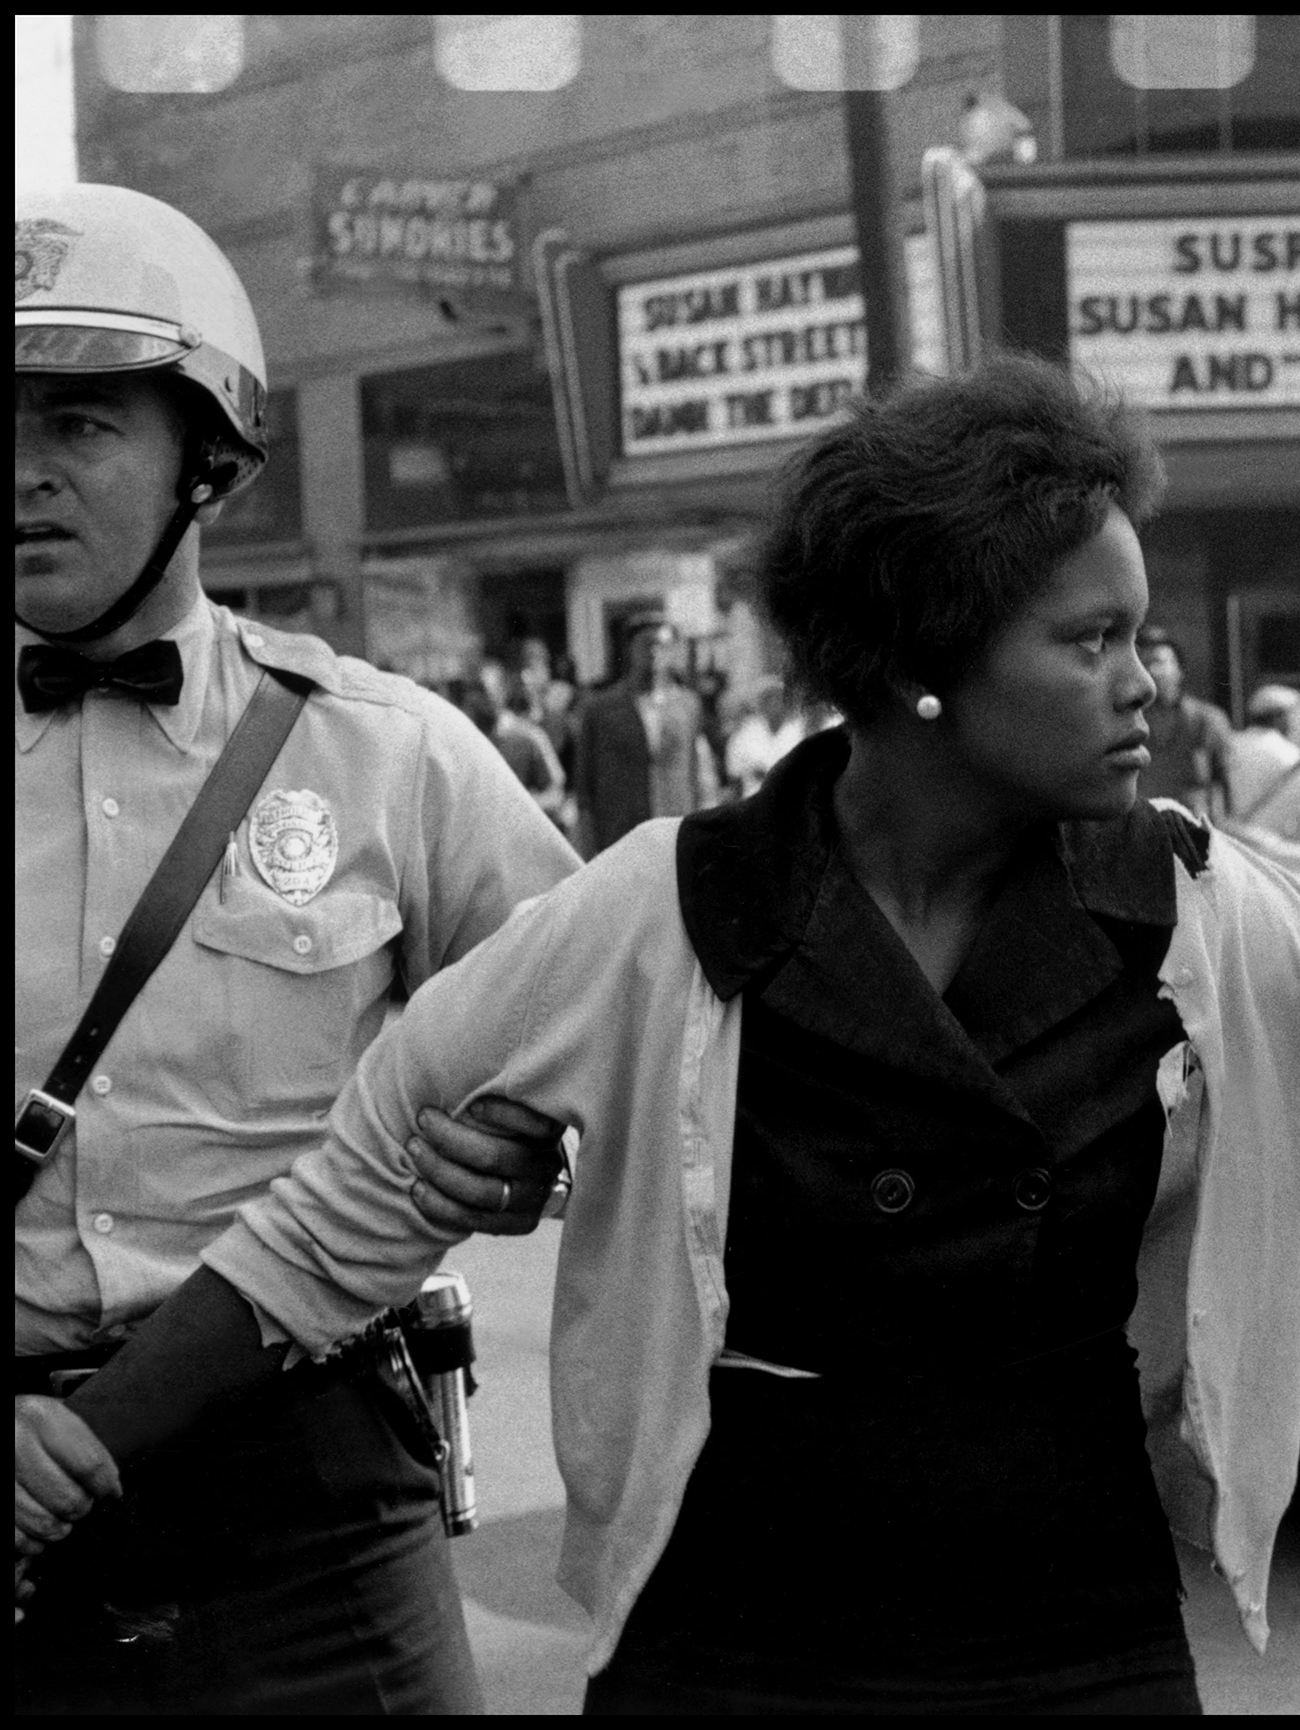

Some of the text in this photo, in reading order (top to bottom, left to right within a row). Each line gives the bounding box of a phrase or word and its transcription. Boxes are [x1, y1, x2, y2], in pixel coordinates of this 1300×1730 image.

[645, 280, 741, 334] SUSAN
[1077, 292, 1246, 337] SUSAN
[726, 390, 774, 426] THE
